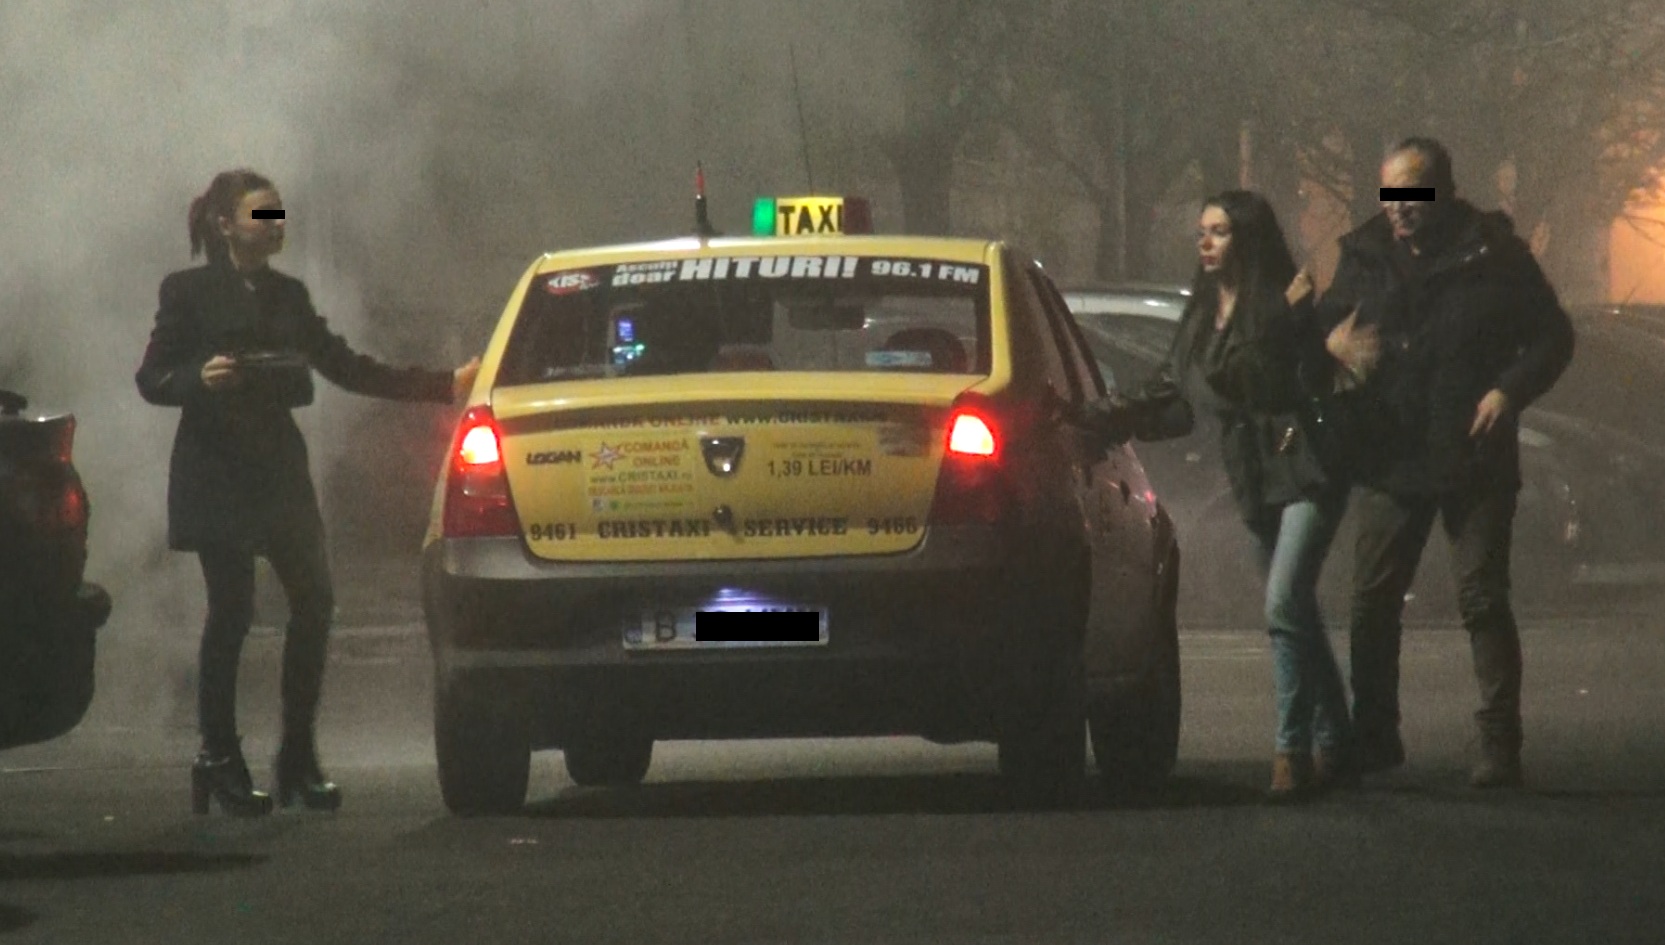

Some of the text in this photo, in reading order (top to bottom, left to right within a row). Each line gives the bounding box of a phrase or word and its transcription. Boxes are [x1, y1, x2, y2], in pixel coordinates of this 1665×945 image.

[779, 205, 844, 235] TAXI
[612, 271, 677, 287] doar
[679, 256, 860, 281] HITURI!
[871, 260, 932, 279] 96.1
[938, 265, 980, 284] FM
[526, 451, 582, 465] LOGAN
[768, 460, 872, 479] 1,39 LEI/KM
[530, 523, 577, 541] 9461
[598, 520, 711, 539] CRISTAXI
[743, 517, 849, 537] SERVICE
[655, 610, 677, 642] B
